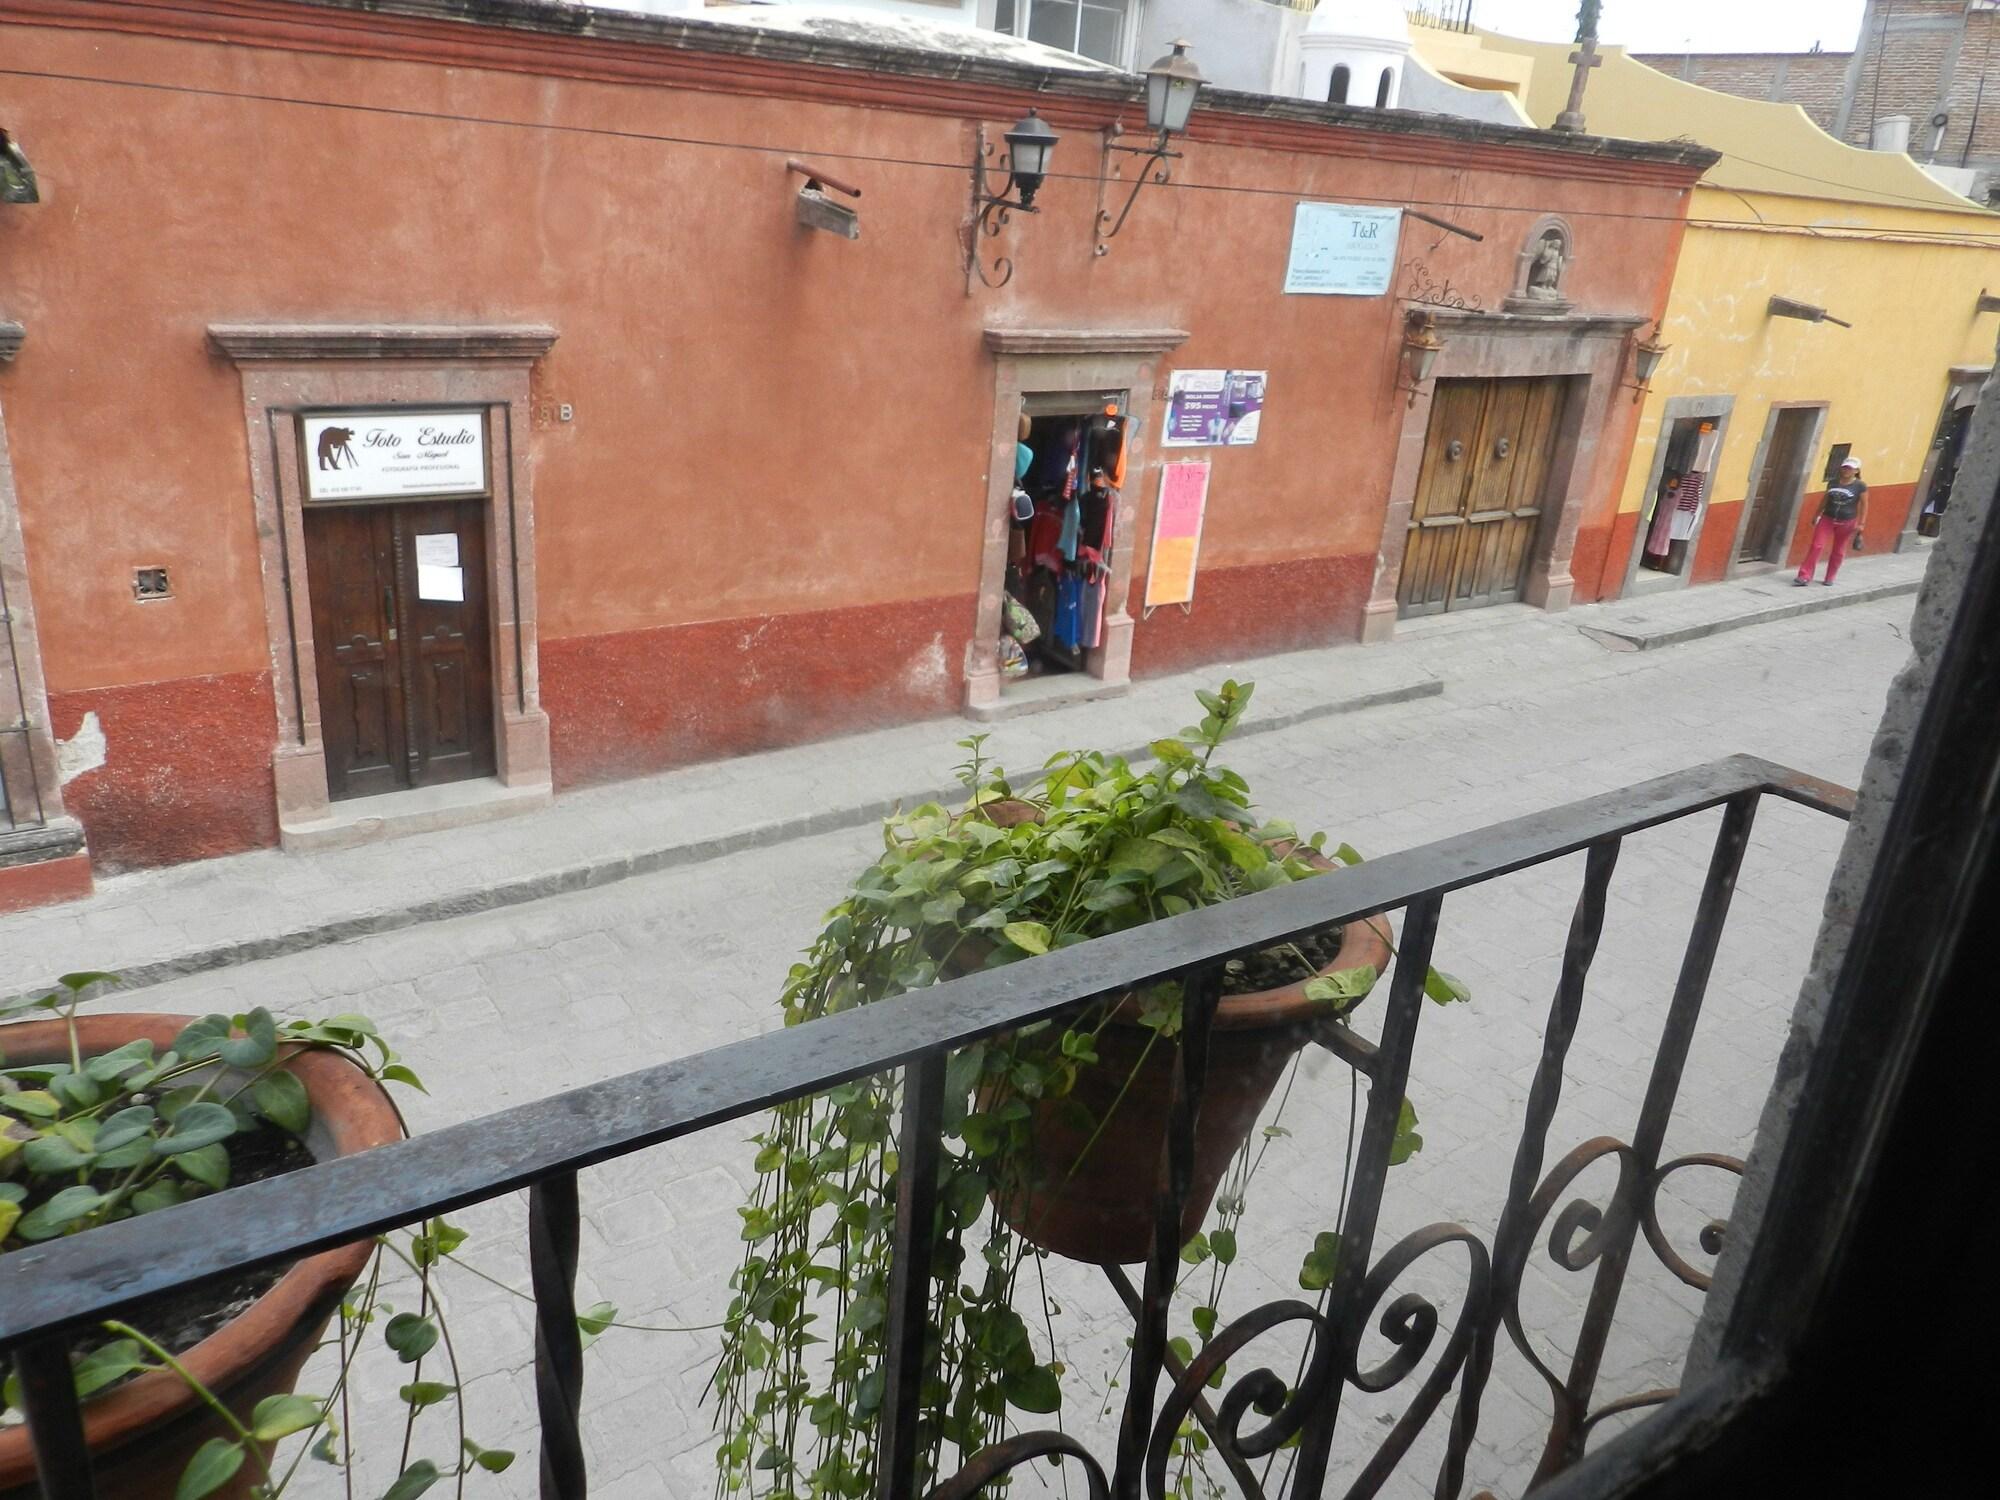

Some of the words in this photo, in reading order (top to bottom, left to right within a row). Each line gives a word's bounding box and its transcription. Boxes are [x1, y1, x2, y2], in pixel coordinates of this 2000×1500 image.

[1352, 221, 1378, 239] T&R
[417, 426, 476, 446] Estudio
[416, 450, 449, 460] Miguel
